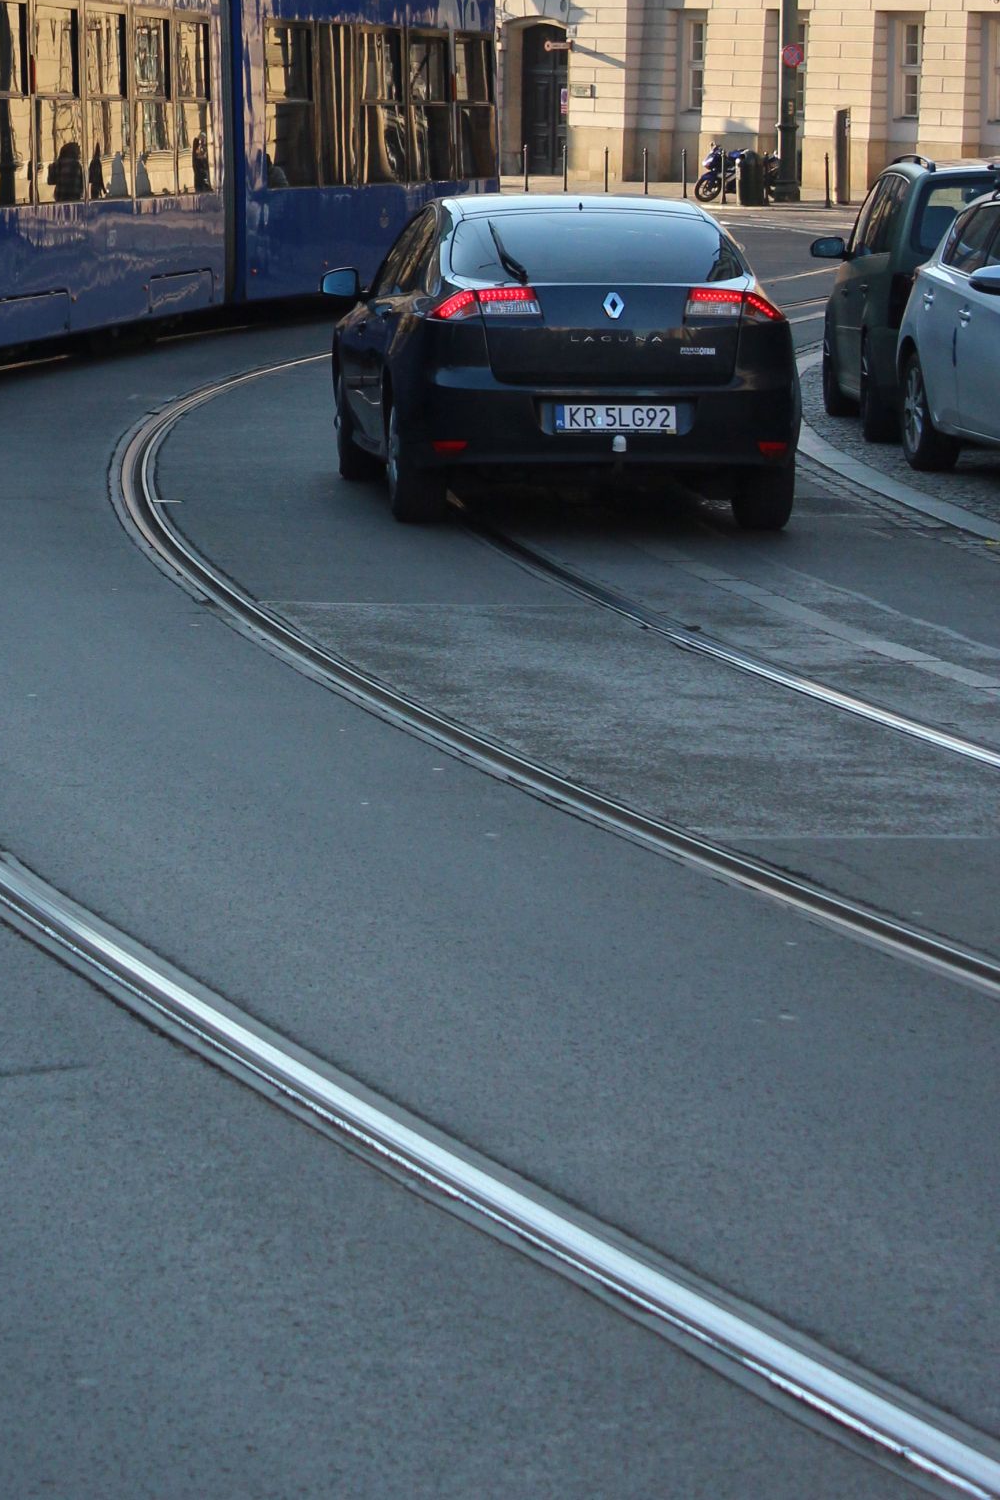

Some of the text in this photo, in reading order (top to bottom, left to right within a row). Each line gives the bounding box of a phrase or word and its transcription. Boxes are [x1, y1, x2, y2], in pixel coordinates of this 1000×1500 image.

[570, 335, 663, 343] LAGUNA
[568, 406, 671, 428] KR 5LG92
